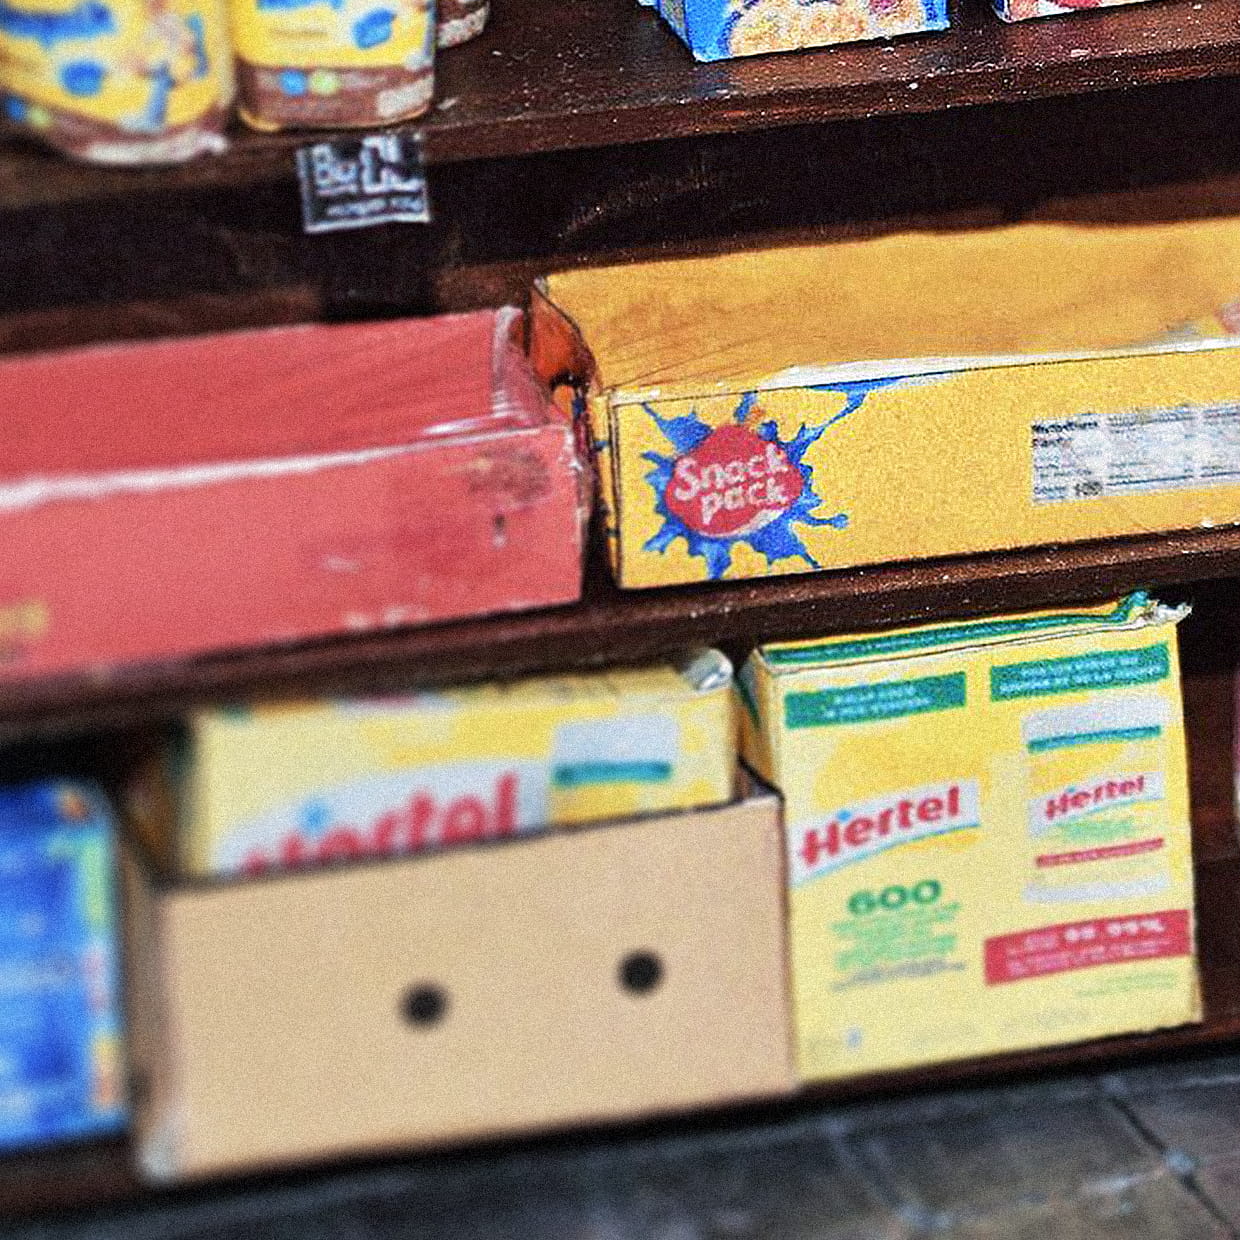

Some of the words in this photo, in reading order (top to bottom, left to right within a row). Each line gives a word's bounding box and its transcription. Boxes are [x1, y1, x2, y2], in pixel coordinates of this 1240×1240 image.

[674, 443, 789, 501] Snack
[701, 477, 789, 525] pack
[1045, 775, 1145, 821] Hertel
[800, 785, 961, 867] Hertel
[847, 879, 943, 916] 600
